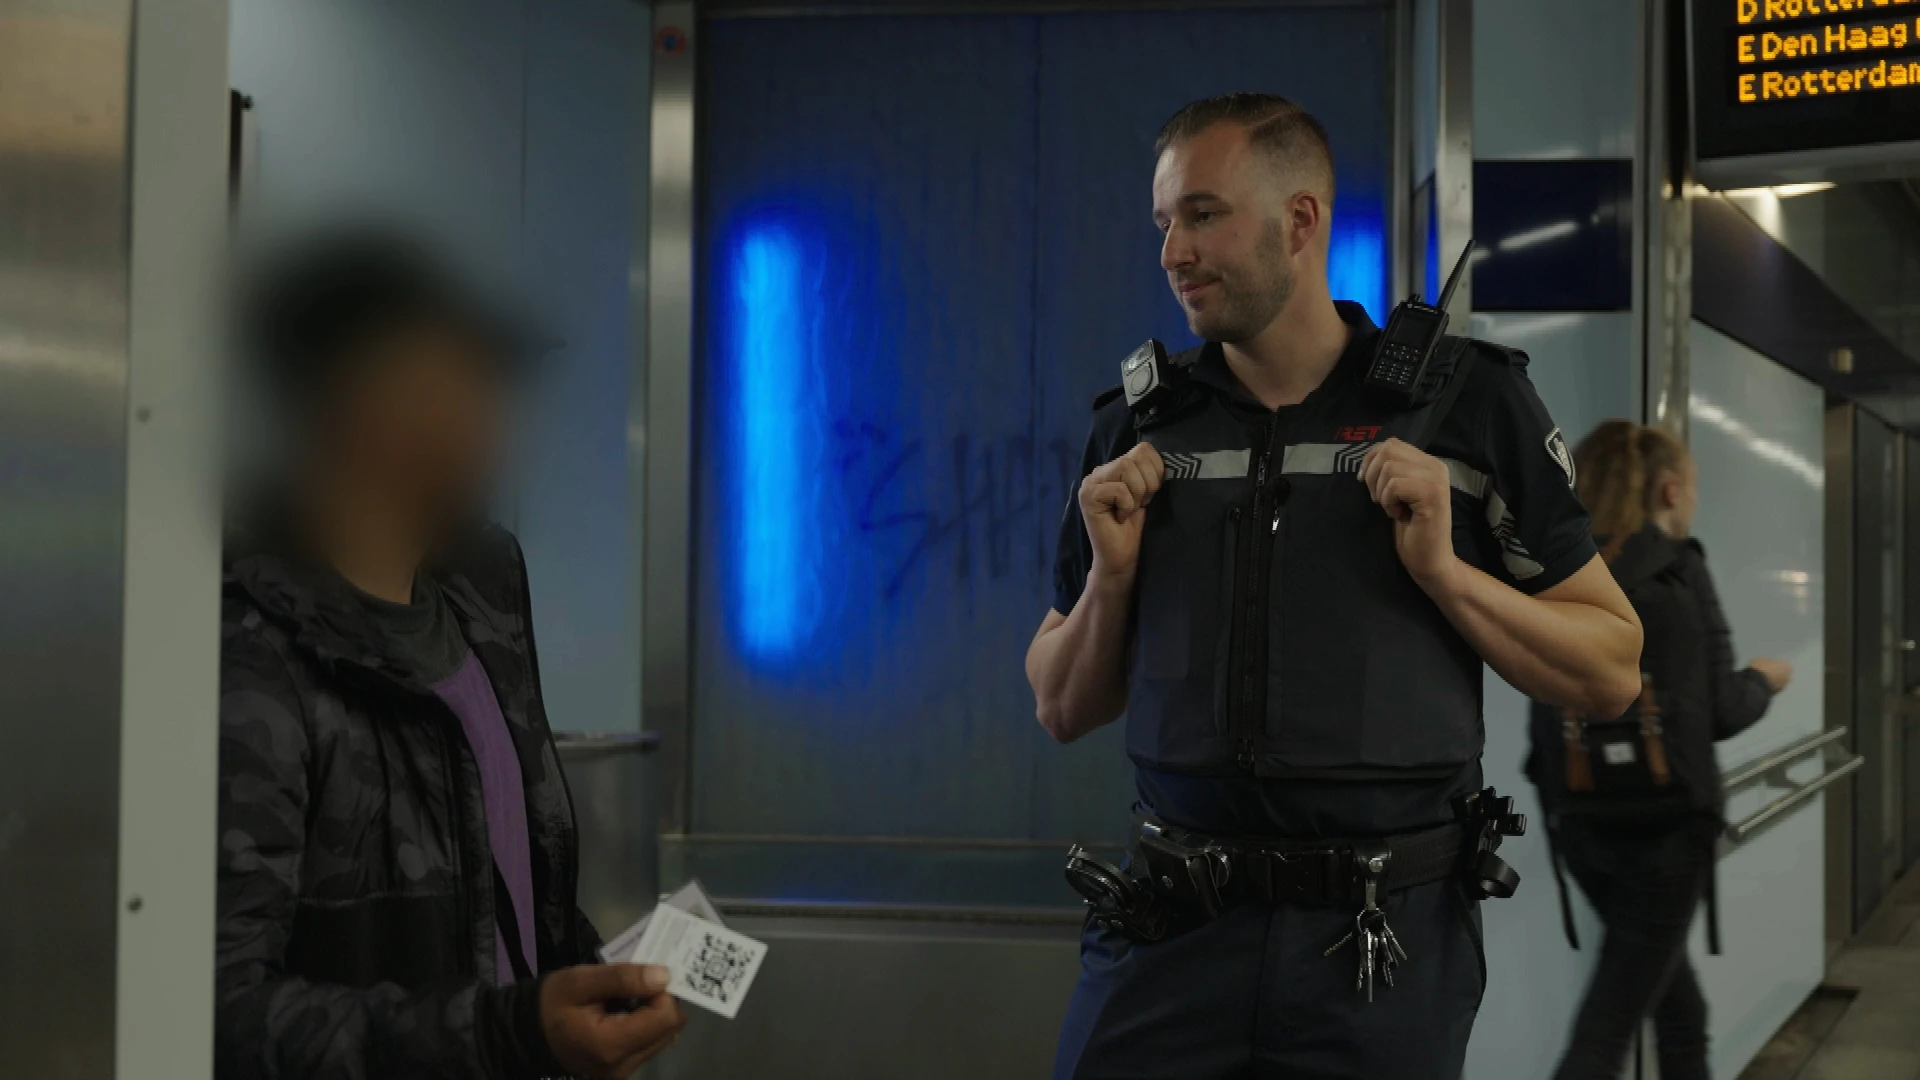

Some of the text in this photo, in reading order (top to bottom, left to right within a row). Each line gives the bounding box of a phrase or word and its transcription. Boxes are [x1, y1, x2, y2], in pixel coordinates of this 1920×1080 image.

[1737, 0, 1758, 24] D
[1738, 34, 1755, 63] E
[1762, 32, 1817, 60] Den
[1824, 23, 1907, 52] Haag
[1738, 74, 1756, 102] E
